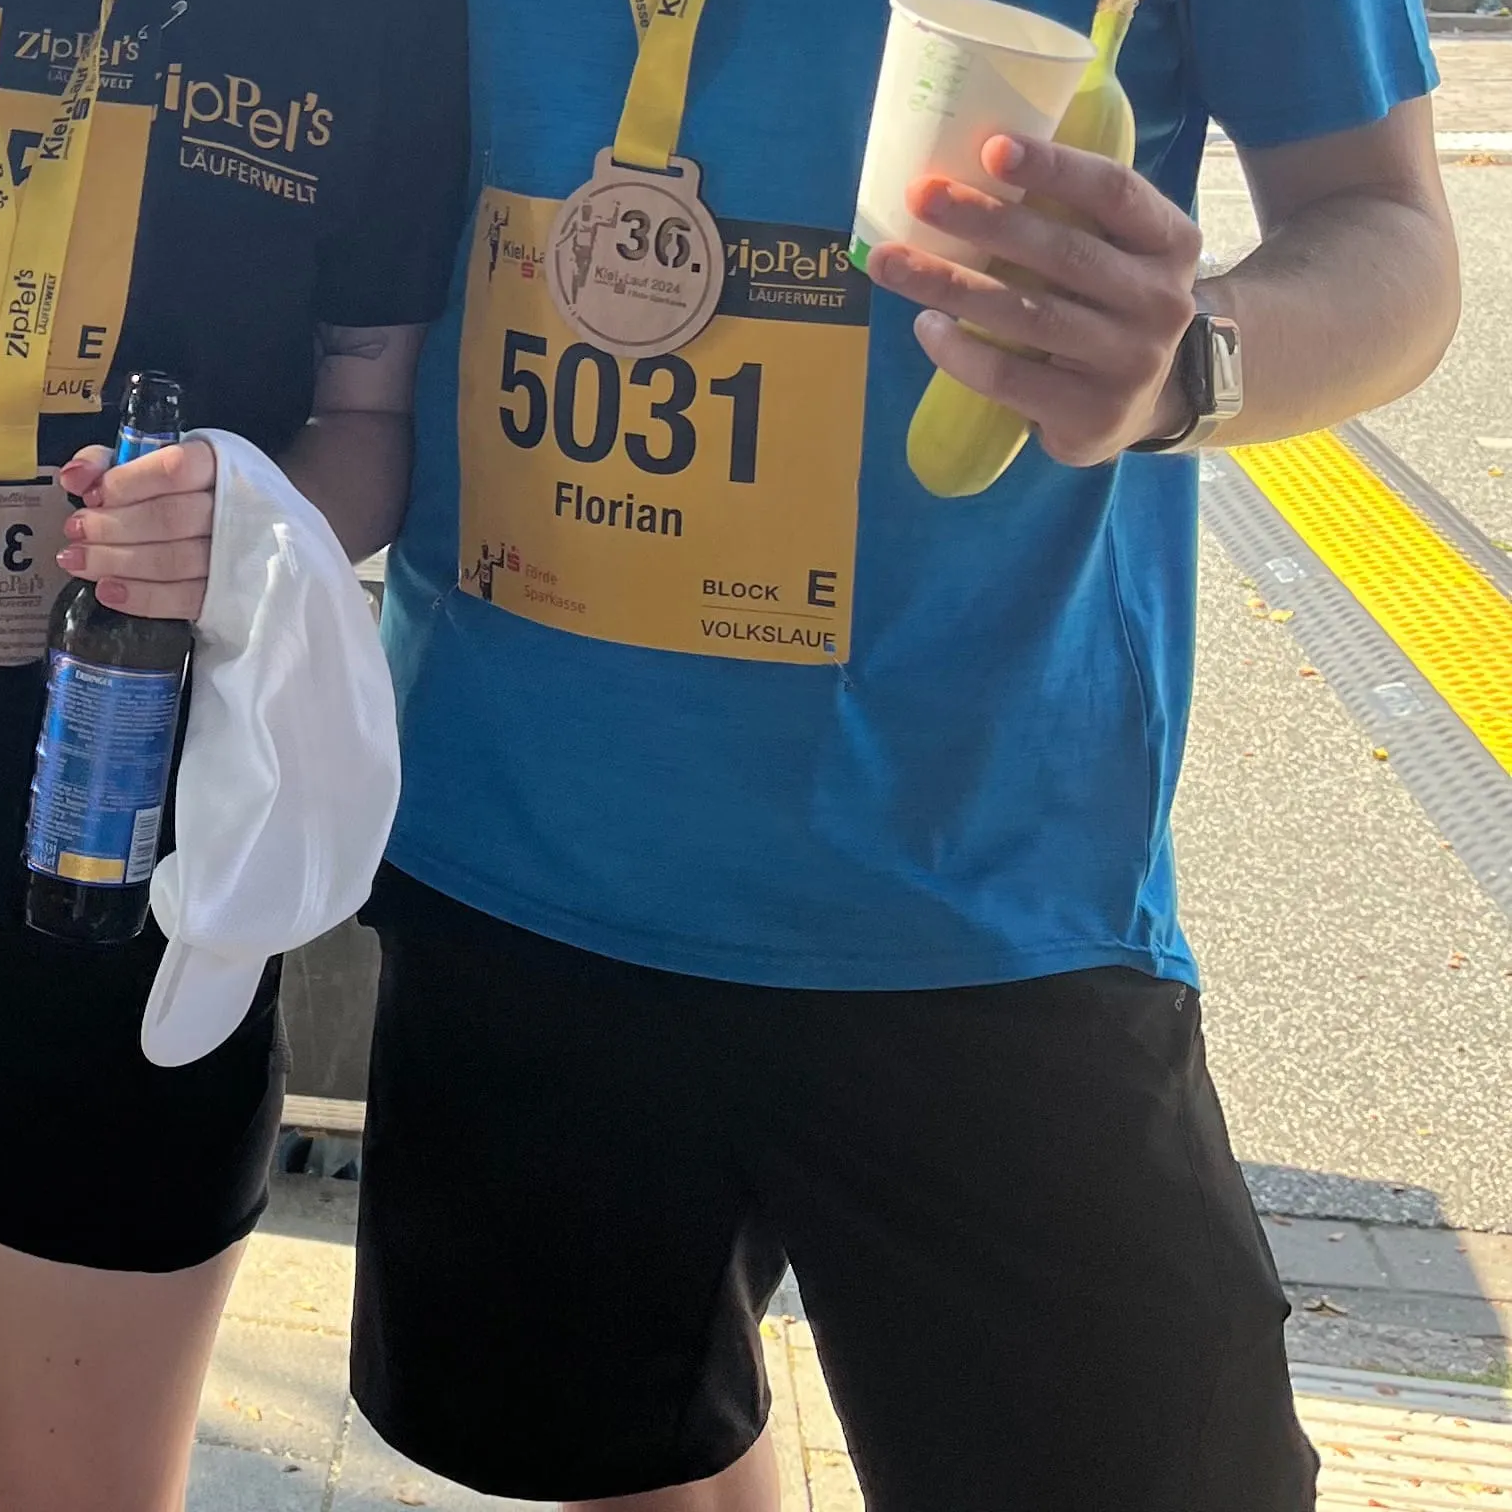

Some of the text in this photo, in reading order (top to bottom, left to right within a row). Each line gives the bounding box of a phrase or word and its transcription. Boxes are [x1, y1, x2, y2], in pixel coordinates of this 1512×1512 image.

[154, 63, 334, 153] ipPel's
[179, 147, 317, 205] LÄUFERWELT
[651, 278, 681, 295] 2024
[749, 288, 846, 308] LÄUFERWELT
[5, 269, 36, 358] ZipPel's
[77, 325, 107, 359] E
[498, 329, 763, 486] 5031
[554, 481, 684, 538] Florian
[524, 584, 587, 614] Sparkasse
[702, 569, 838, 609] BLOCK E
